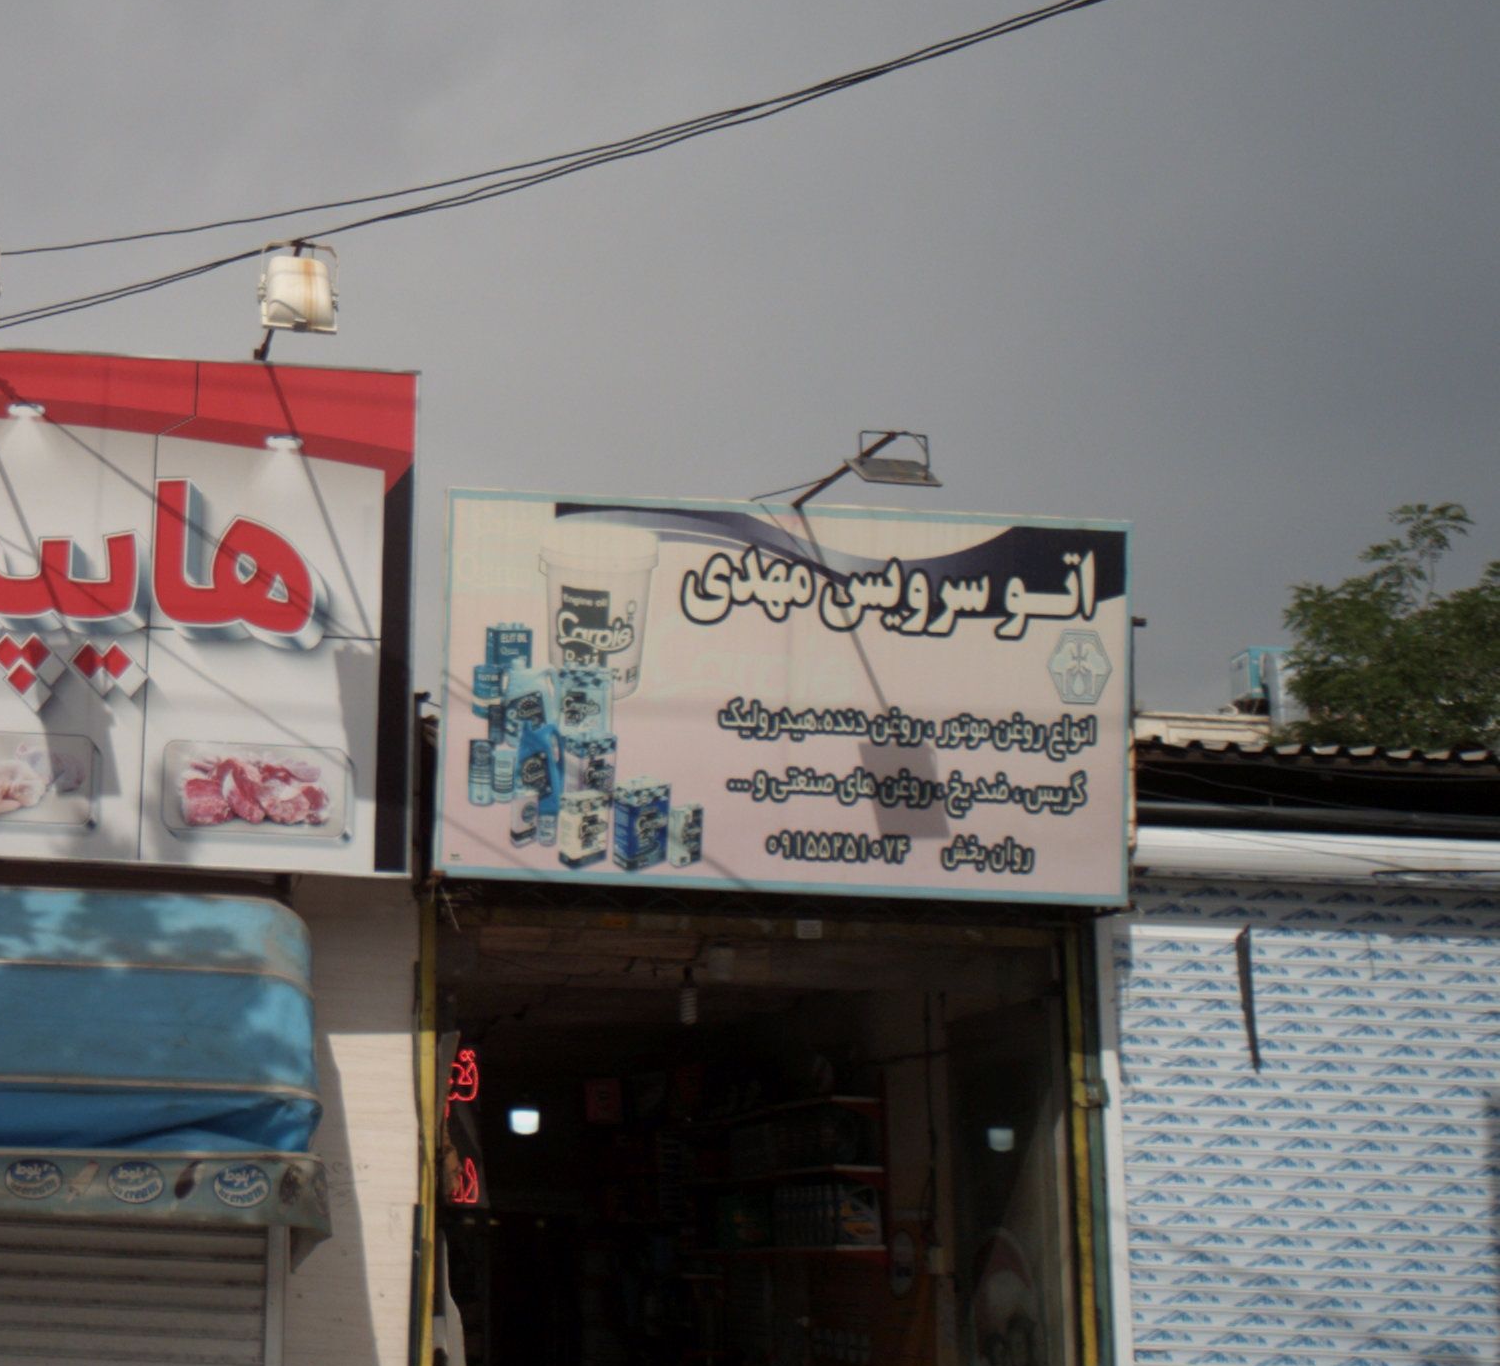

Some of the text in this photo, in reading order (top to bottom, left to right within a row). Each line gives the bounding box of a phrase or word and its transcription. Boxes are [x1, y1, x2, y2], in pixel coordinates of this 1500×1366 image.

[680, 545, 817, 626] مهدی
[819, 557, 993, 638] سرویس
[993, 711, 1048, 752] روغن
[1048, 714, 1097, 762] انواع
[770, 766, 837, 803] صنعتی
[837, 766, 879, 807] های
